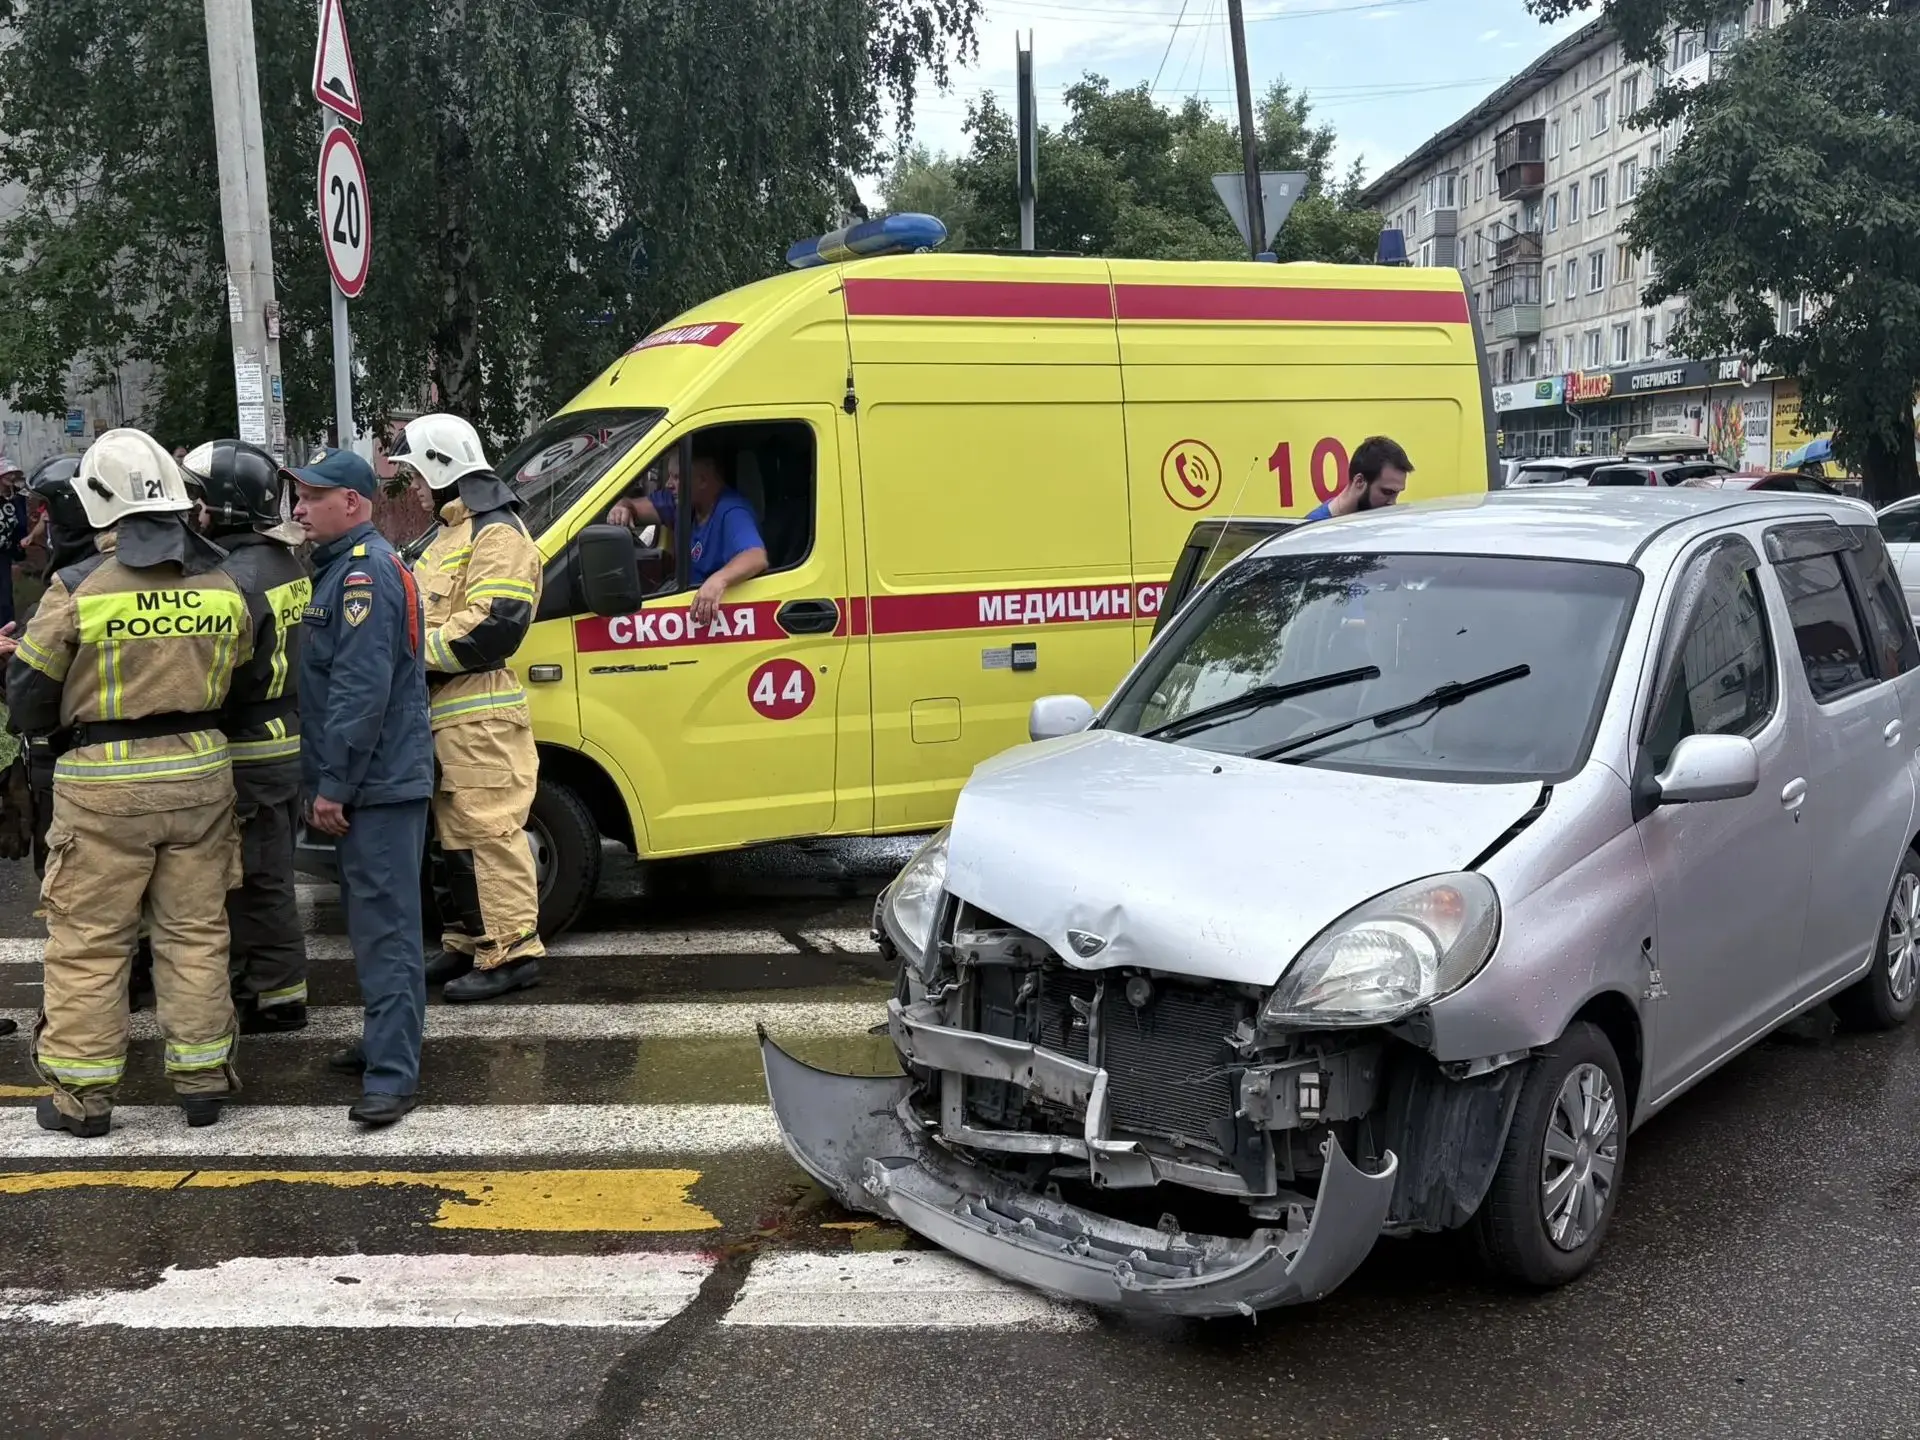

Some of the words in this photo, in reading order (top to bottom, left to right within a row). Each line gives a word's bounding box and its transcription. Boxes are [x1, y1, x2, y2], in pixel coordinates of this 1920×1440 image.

[331, 174, 361, 249] 20
[1631, 369, 1683, 390] СУПЕРМАРКЕТ
[145, 479, 164, 499] 21
[136, 590, 202, 611] МЧС
[289, 580, 308, 600] МЧС
[106, 615, 232, 637] РОССИИ
[608, 607, 755, 644] СКОРАЯ
[753, 669, 805, 706] 44
